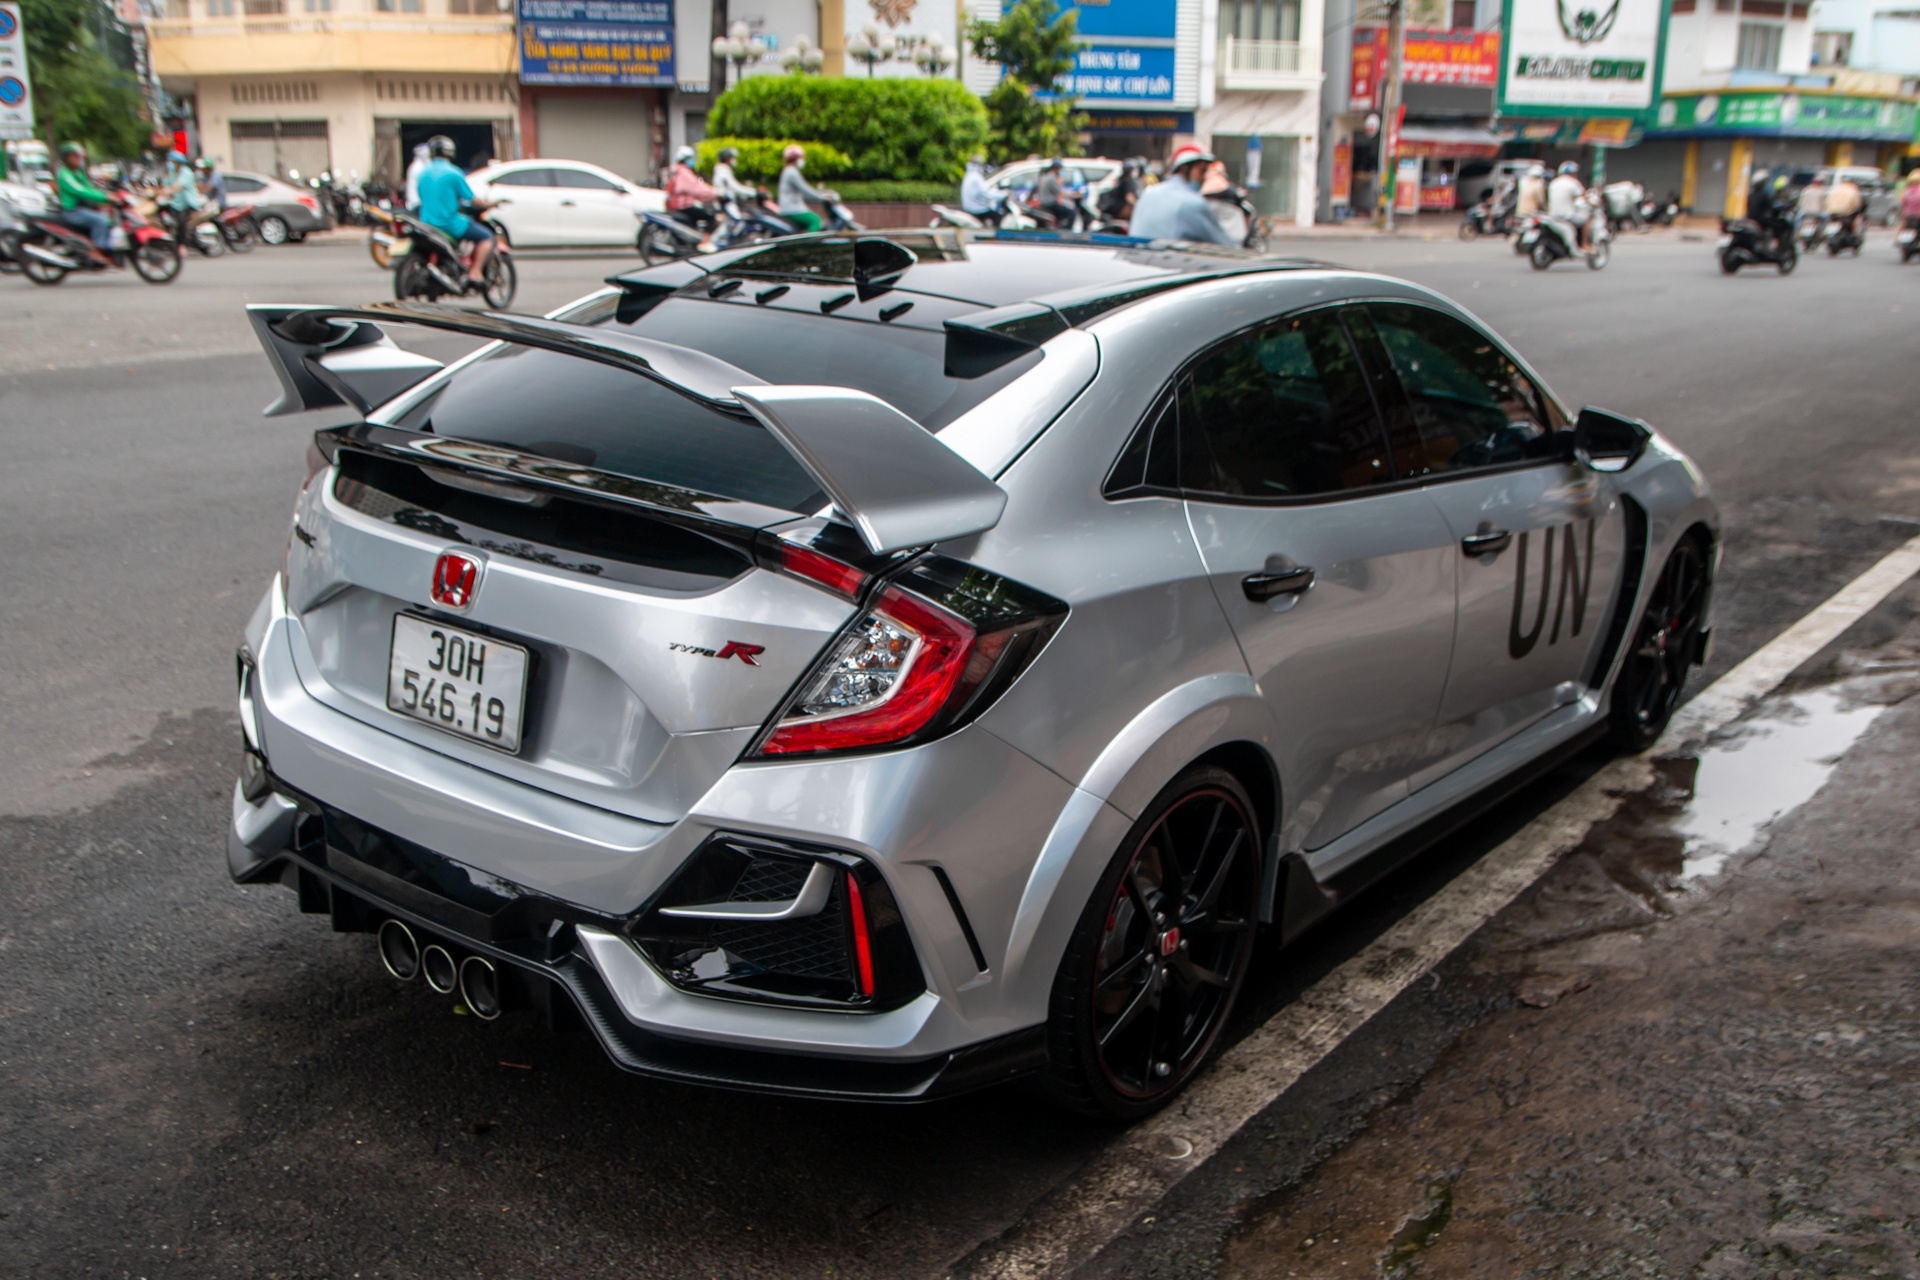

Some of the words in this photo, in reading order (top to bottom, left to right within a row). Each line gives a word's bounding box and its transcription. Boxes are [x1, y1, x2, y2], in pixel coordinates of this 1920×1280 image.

[1078, 51, 1116, 70] TRUNG
[1509, 518, 1594, 660] UN
[428, 630, 486, 685] 30H
[669, 642, 717, 658] TYPE
[715, 640, 765, 667] R
[402, 668, 505, 739] 546.19
